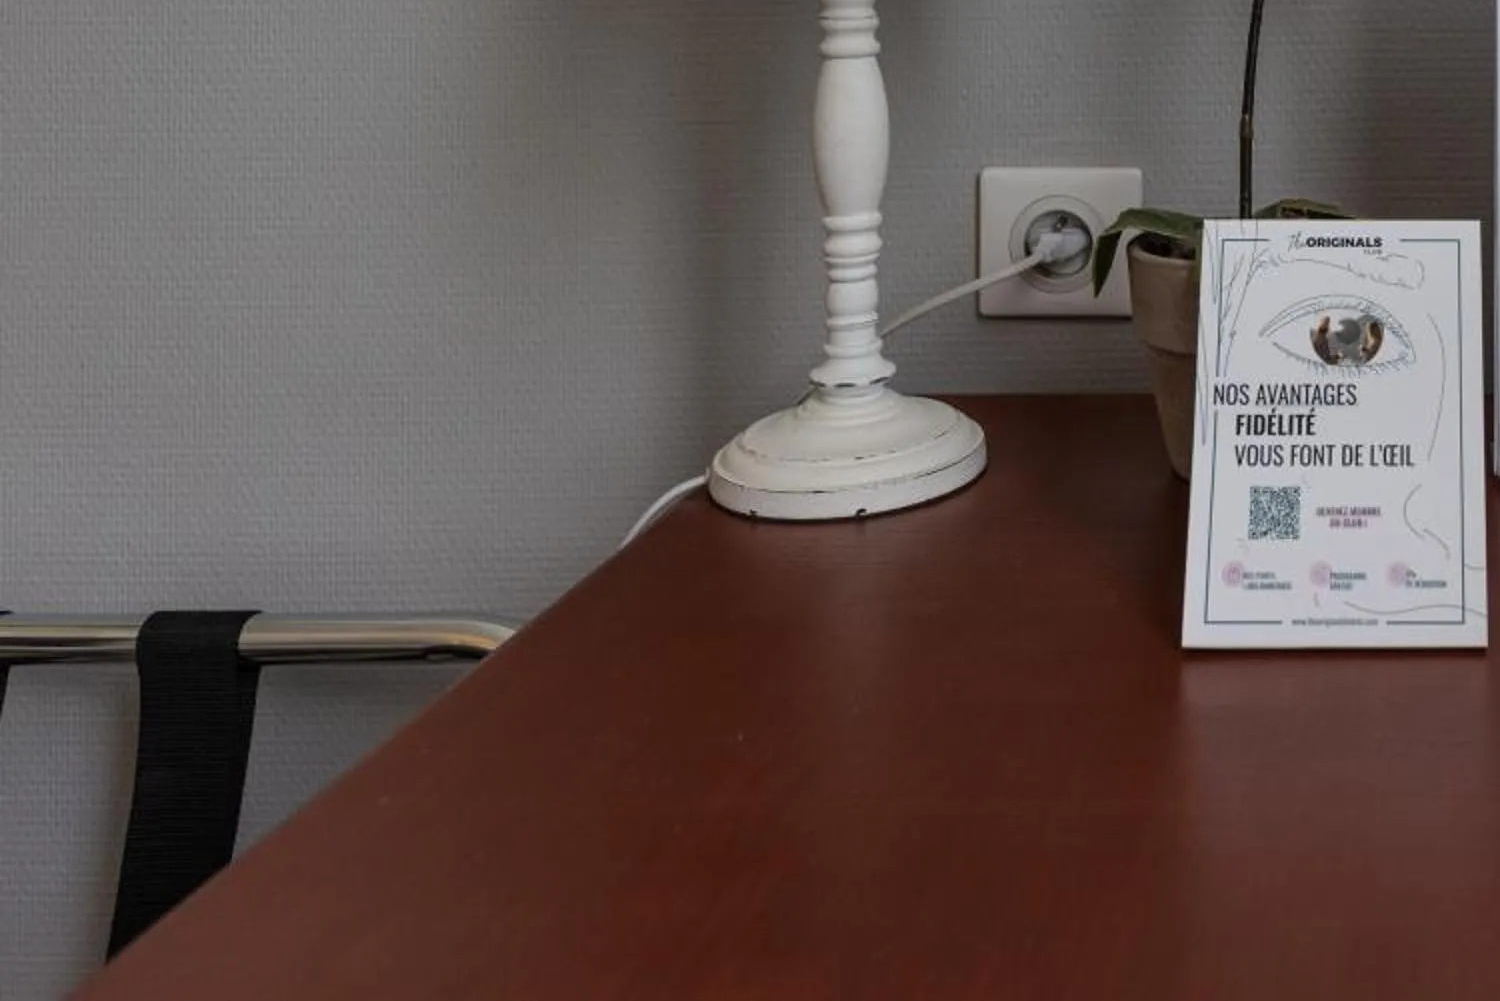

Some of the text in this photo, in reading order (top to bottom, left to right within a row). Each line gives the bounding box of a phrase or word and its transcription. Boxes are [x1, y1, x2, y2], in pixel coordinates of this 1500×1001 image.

[1305, 236, 1383, 248] ORIGINALS
[1213, 383, 1358, 406] NOS AVANTAGES
[1234, 407, 1317, 436] FIDÉLITÉ
[1235, 444, 1416, 468] VOUS FONT DE L'ŒIL
